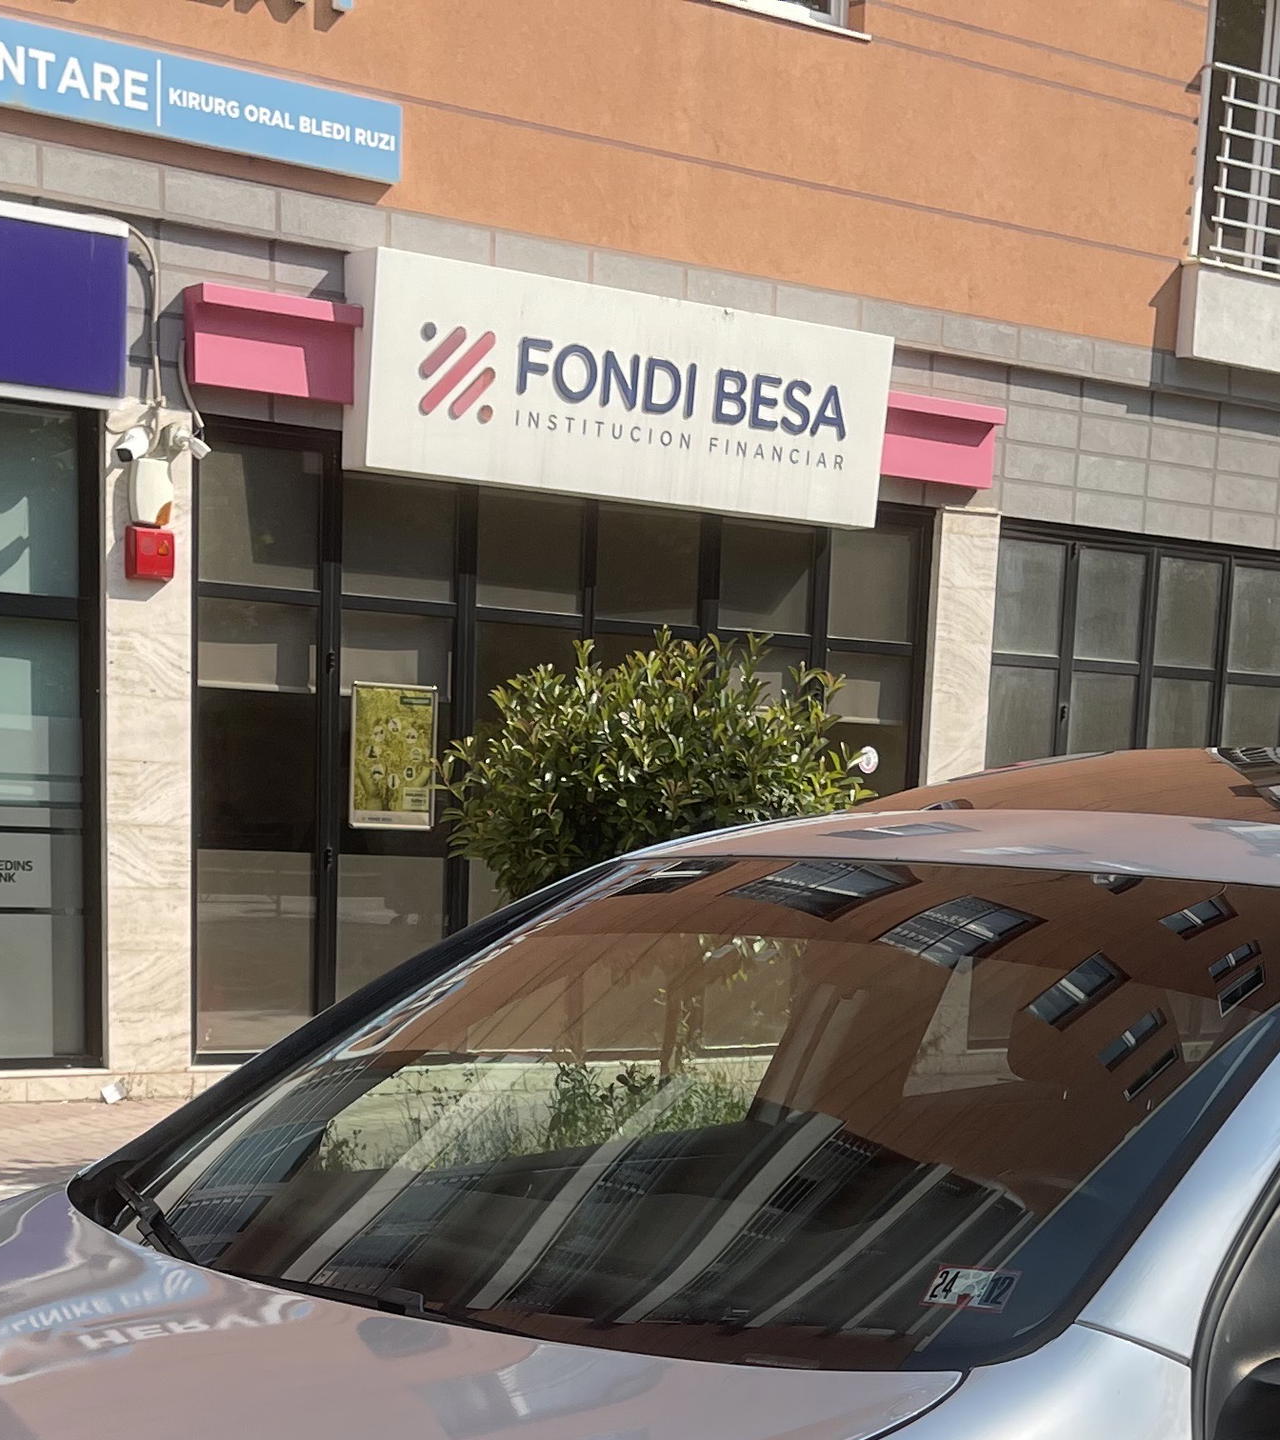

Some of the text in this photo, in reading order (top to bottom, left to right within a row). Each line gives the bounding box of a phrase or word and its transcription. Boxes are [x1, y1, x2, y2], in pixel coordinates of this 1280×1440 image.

[169, 87, 396, 151] KIRURG ORAL BLEDI RUZI
[516, 336, 846, 441] FONDI BESA
[515, 410, 845, 470] INSTITUCION FINANCIAR
[929, 1270, 1016, 1305] 24 12
